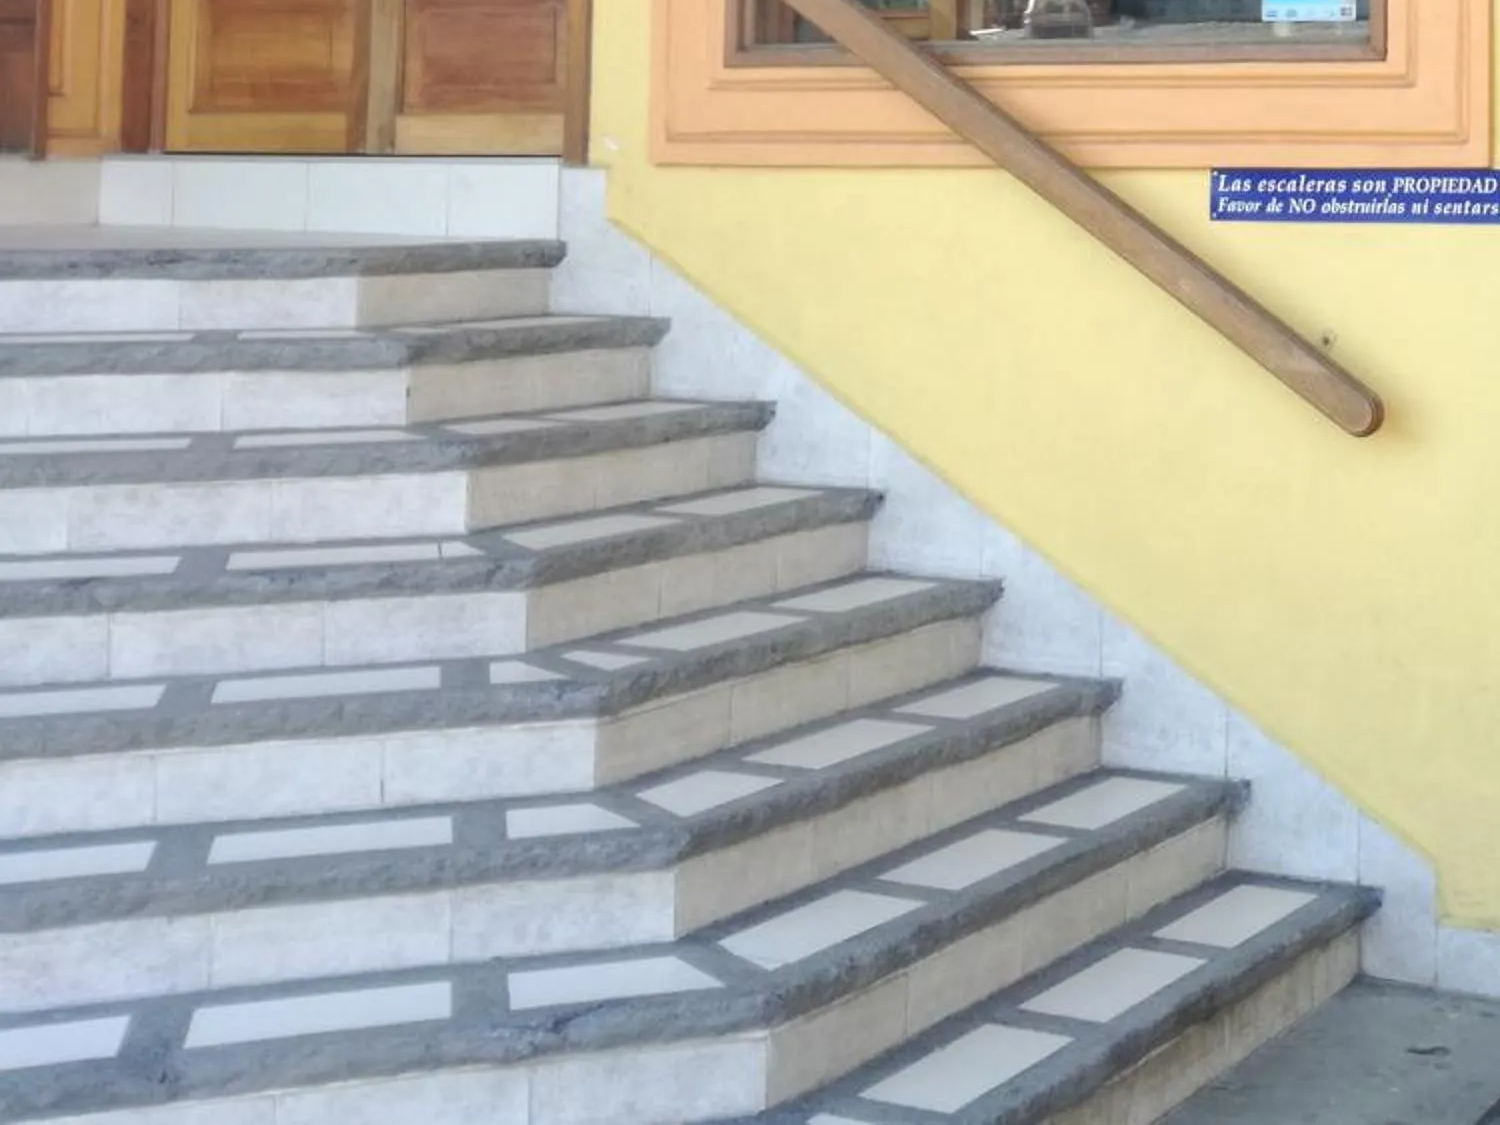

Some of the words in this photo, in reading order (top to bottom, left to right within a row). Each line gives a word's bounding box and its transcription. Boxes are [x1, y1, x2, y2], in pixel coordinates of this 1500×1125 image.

[1218, 174, 1252, 192] Las
[1257, 174, 1347, 193] escaleras
[1352, 178, 1387, 194] son
[1391, 176, 1498, 195] PROPIEDAD
[1218, 196, 1261, 213] Favor
[1265, 196, 1283, 213] de
[1288, 197, 1316, 215] NO
[1321, 196, 1406, 216] obstruirlas
[1411, 198, 1429, 216] ni
